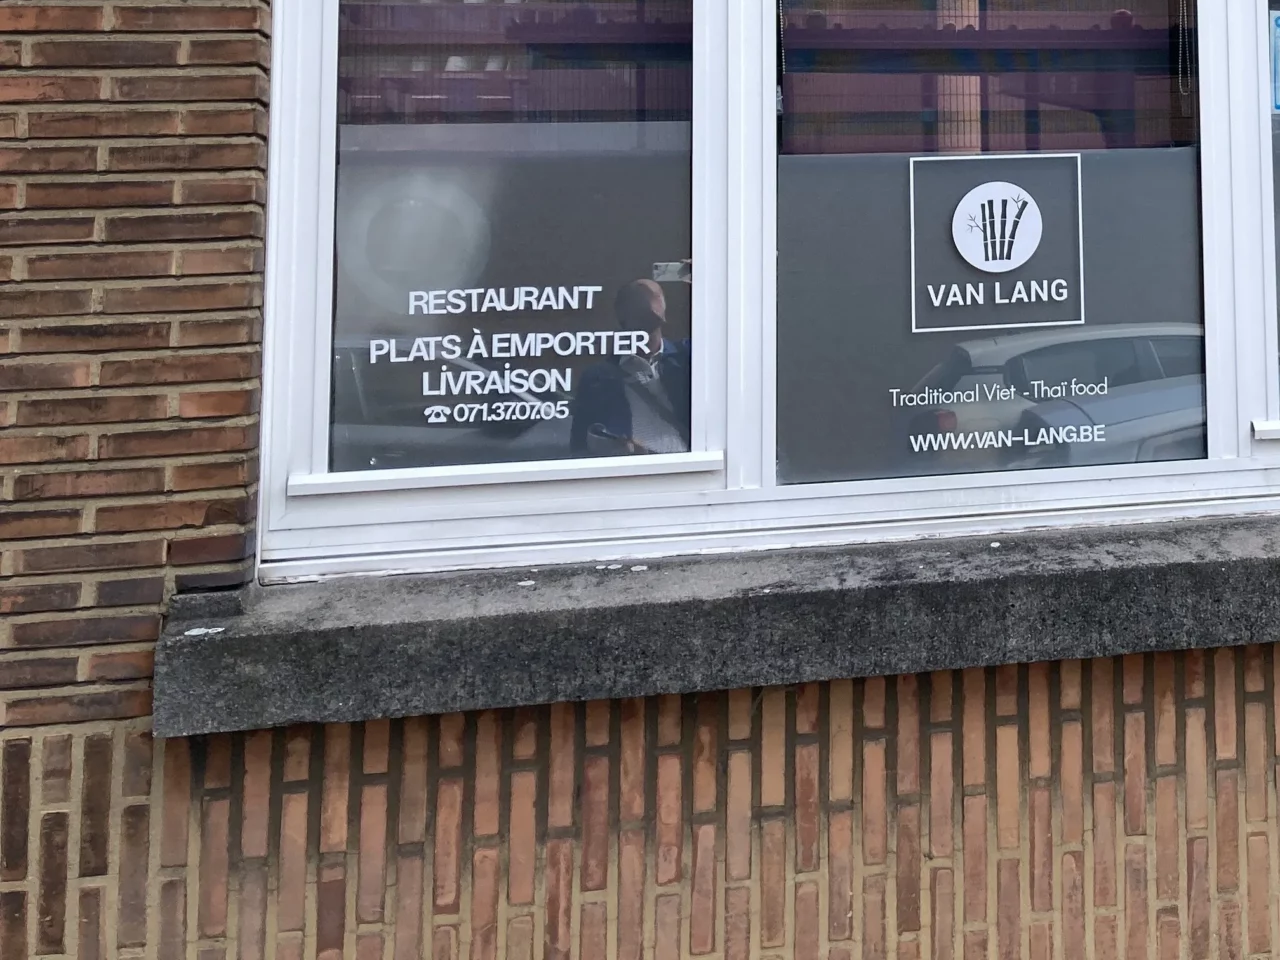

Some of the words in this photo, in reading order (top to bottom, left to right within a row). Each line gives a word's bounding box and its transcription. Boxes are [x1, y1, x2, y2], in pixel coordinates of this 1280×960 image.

[408, 285, 603, 315] RESTAURANT
[927, 282, 985, 307] VAN
[994, 279, 1069, 304] LANG
[369, 334, 462, 364] PLATS
[466, 327, 489, 359] À
[491, 330, 651, 358] EMPORTER
[888, 383, 980, 407] Traditional
[983, 382, 1017, 401] Viet
[1070, 376, 1108, 397] food
[909, 424, 1107, 452] WWW.VAN-LANG.BE
